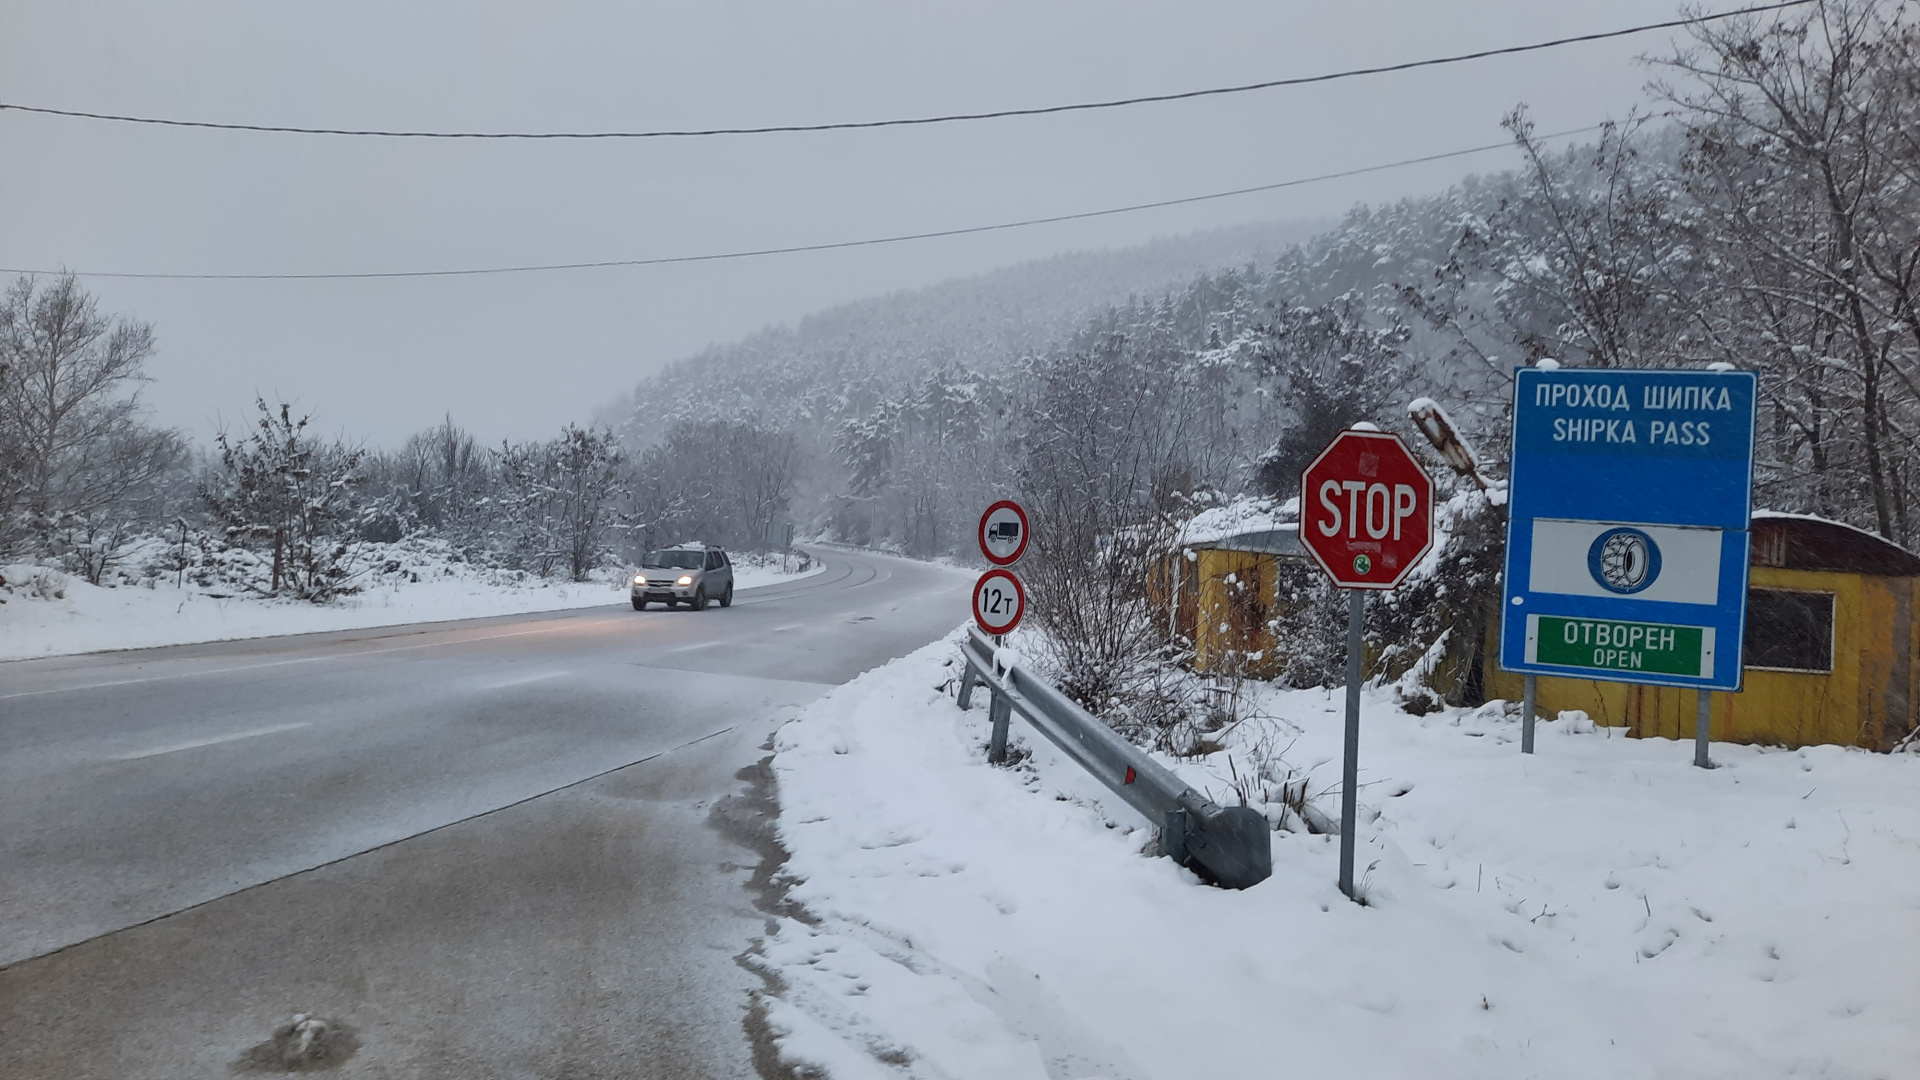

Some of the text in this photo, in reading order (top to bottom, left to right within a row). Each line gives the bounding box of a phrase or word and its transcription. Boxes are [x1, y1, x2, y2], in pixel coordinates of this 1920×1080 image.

[1535, 383, 1732, 412] ПРОХОД ШИПКА
[1552, 418, 1711, 446] SHIPKA PASS
[1317, 479, 1417, 541] STOP
[1563, 620, 1675, 651] ОТВОРЕН
[1593, 648, 1643, 669] OPEN
